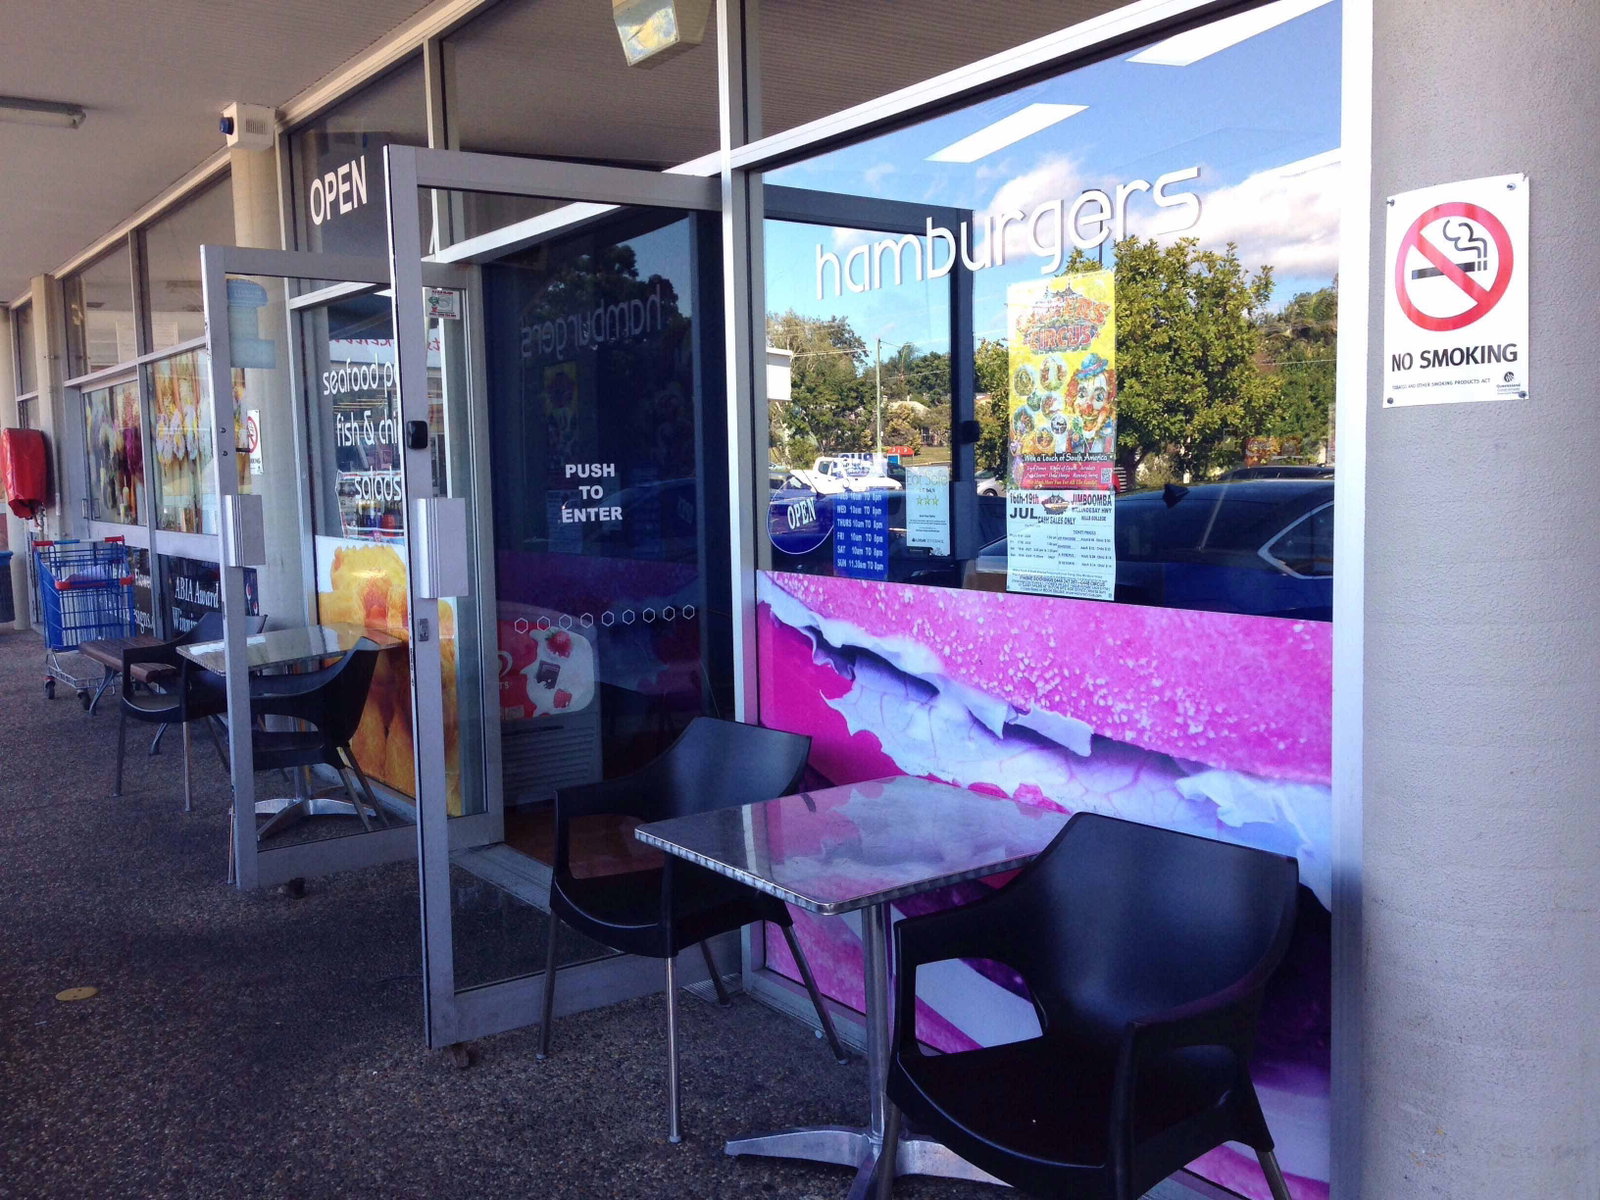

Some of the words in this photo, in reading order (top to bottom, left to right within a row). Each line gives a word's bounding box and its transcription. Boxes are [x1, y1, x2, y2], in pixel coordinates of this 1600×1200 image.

[310, 155, 367, 226] OPEN
[815, 165, 1201, 301] hamburgers
[1030, 325, 1092, 349] CIRCUS
[1391, 352, 1414, 372] NO
[1419, 343, 1518, 369] SMOKING
[322, 352, 379, 396] seafood
[336, 411, 361, 447] fish
[363, 410, 376, 446] &
[1041, 453, 1058, 462] Touch
[1059, 453, 1065, 461] of
[1065, 452, 1082, 462] South
[1083, 452, 1107, 463] America
[565, 463, 615, 478] PUSH
[354, 465, 401, 501] salads
[578, 485, 604, 500] TO
[1071, 494, 1112, 506] JIMBOOMBA
[561, 506, 623, 523] ENTER
[787, 496, 816, 530] OPEN
[837, 505, 847, 514] WED
[850, 505, 862, 515] 10am
[864, 505, 870, 515] TO
[1010, 507, 1038, 519] JUL
[837, 518, 851, 528] THURS
[852, 519, 864, 528] 10am
[865, 519, 871, 528] TO
[1037, 516, 1050, 524] CASH
[1050, 516, 1064, 525] SALES
[1064, 517, 1076, 525] ONLY
[837, 531, 845, 541] FRI
[850, 532, 863, 542] 10am
[865, 533, 872, 542] TO
[837, 545, 846, 554] SAT
[852, 546, 863, 555] 10am
[865, 546, 872, 556] TO
[837, 558, 847, 567] SUN
[867, 560, 873, 570] TO
[174, 576, 194, 602] ABIA
[194, 580, 220, 609] Award
